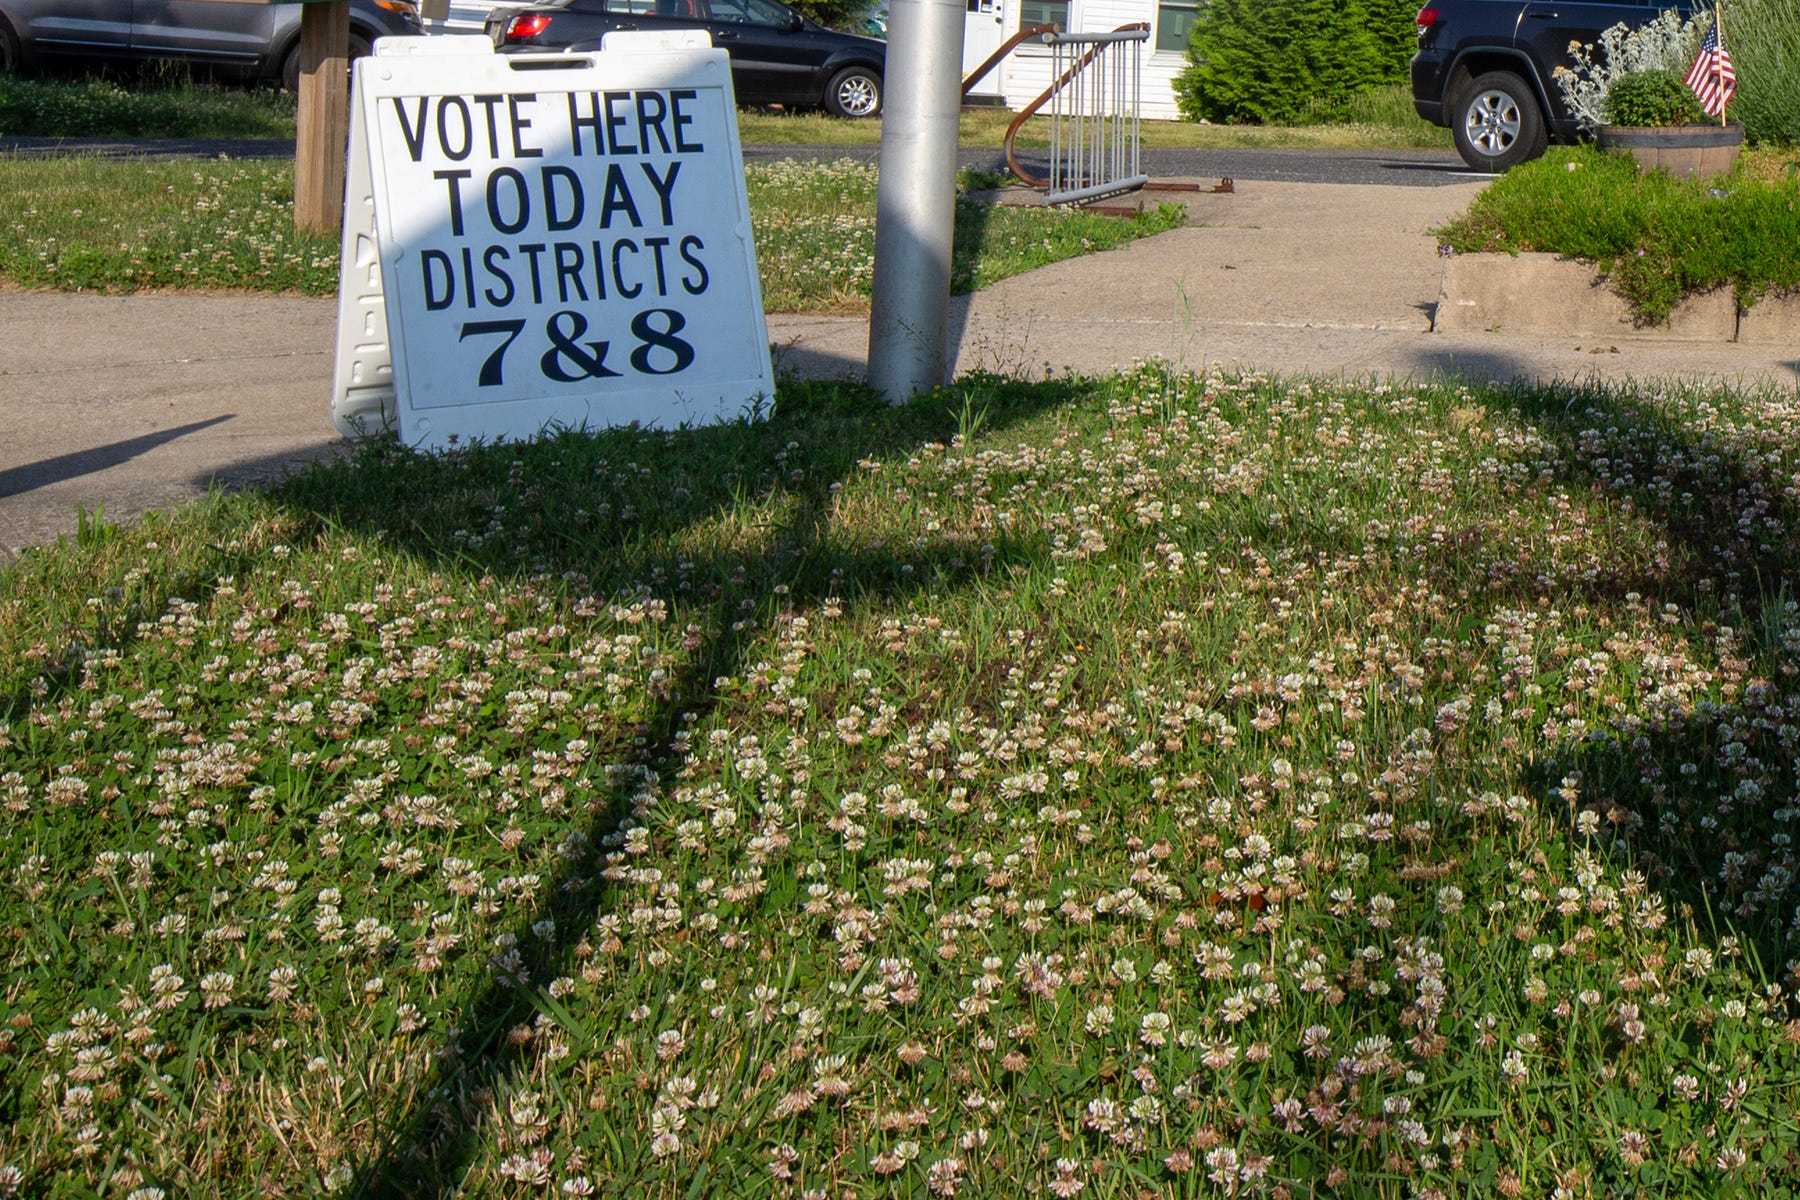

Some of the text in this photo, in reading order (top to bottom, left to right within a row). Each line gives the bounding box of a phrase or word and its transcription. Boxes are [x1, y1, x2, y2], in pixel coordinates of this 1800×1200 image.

[391, 90, 704, 162] VOTE HERE
[433, 161, 682, 237] TODAY
[421, 235, 710, 312] DISTRICTS
[458, 308, 696, 387] 7&8
